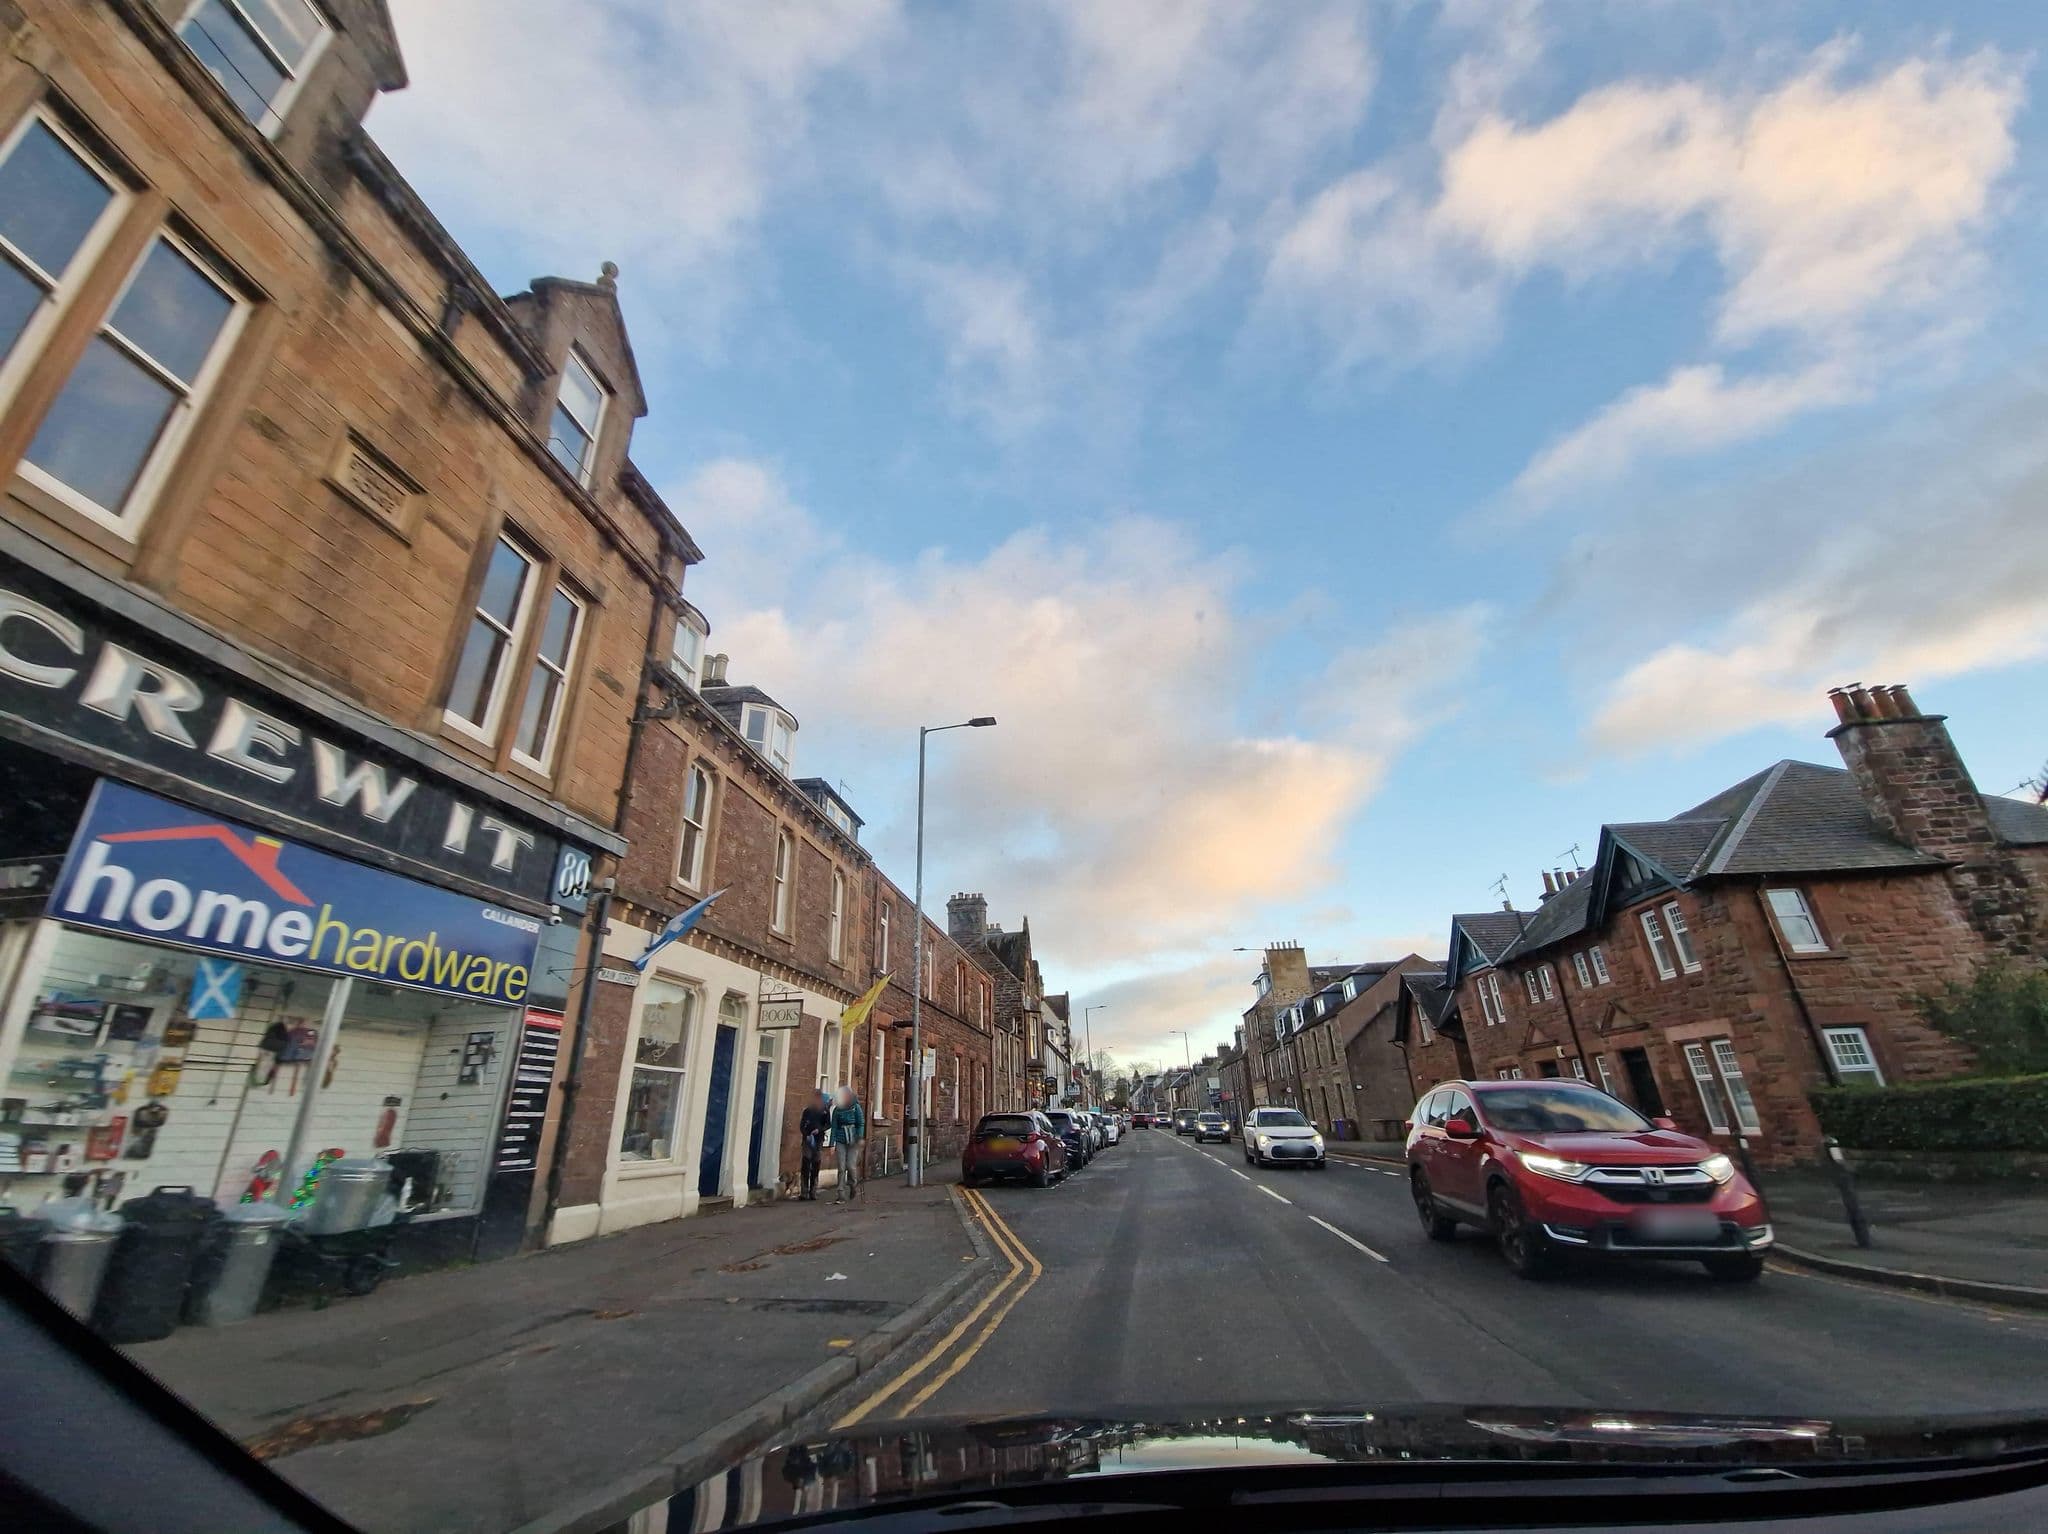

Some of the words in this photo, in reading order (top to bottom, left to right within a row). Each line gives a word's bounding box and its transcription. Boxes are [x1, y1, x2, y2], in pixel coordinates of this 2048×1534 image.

[442, 801, 535, 873] IT
[558, 852, 593, 901] 89
[481, 908, 541, 934] CALLANDER
[761, 1008, 800, 1022] BOOKS
